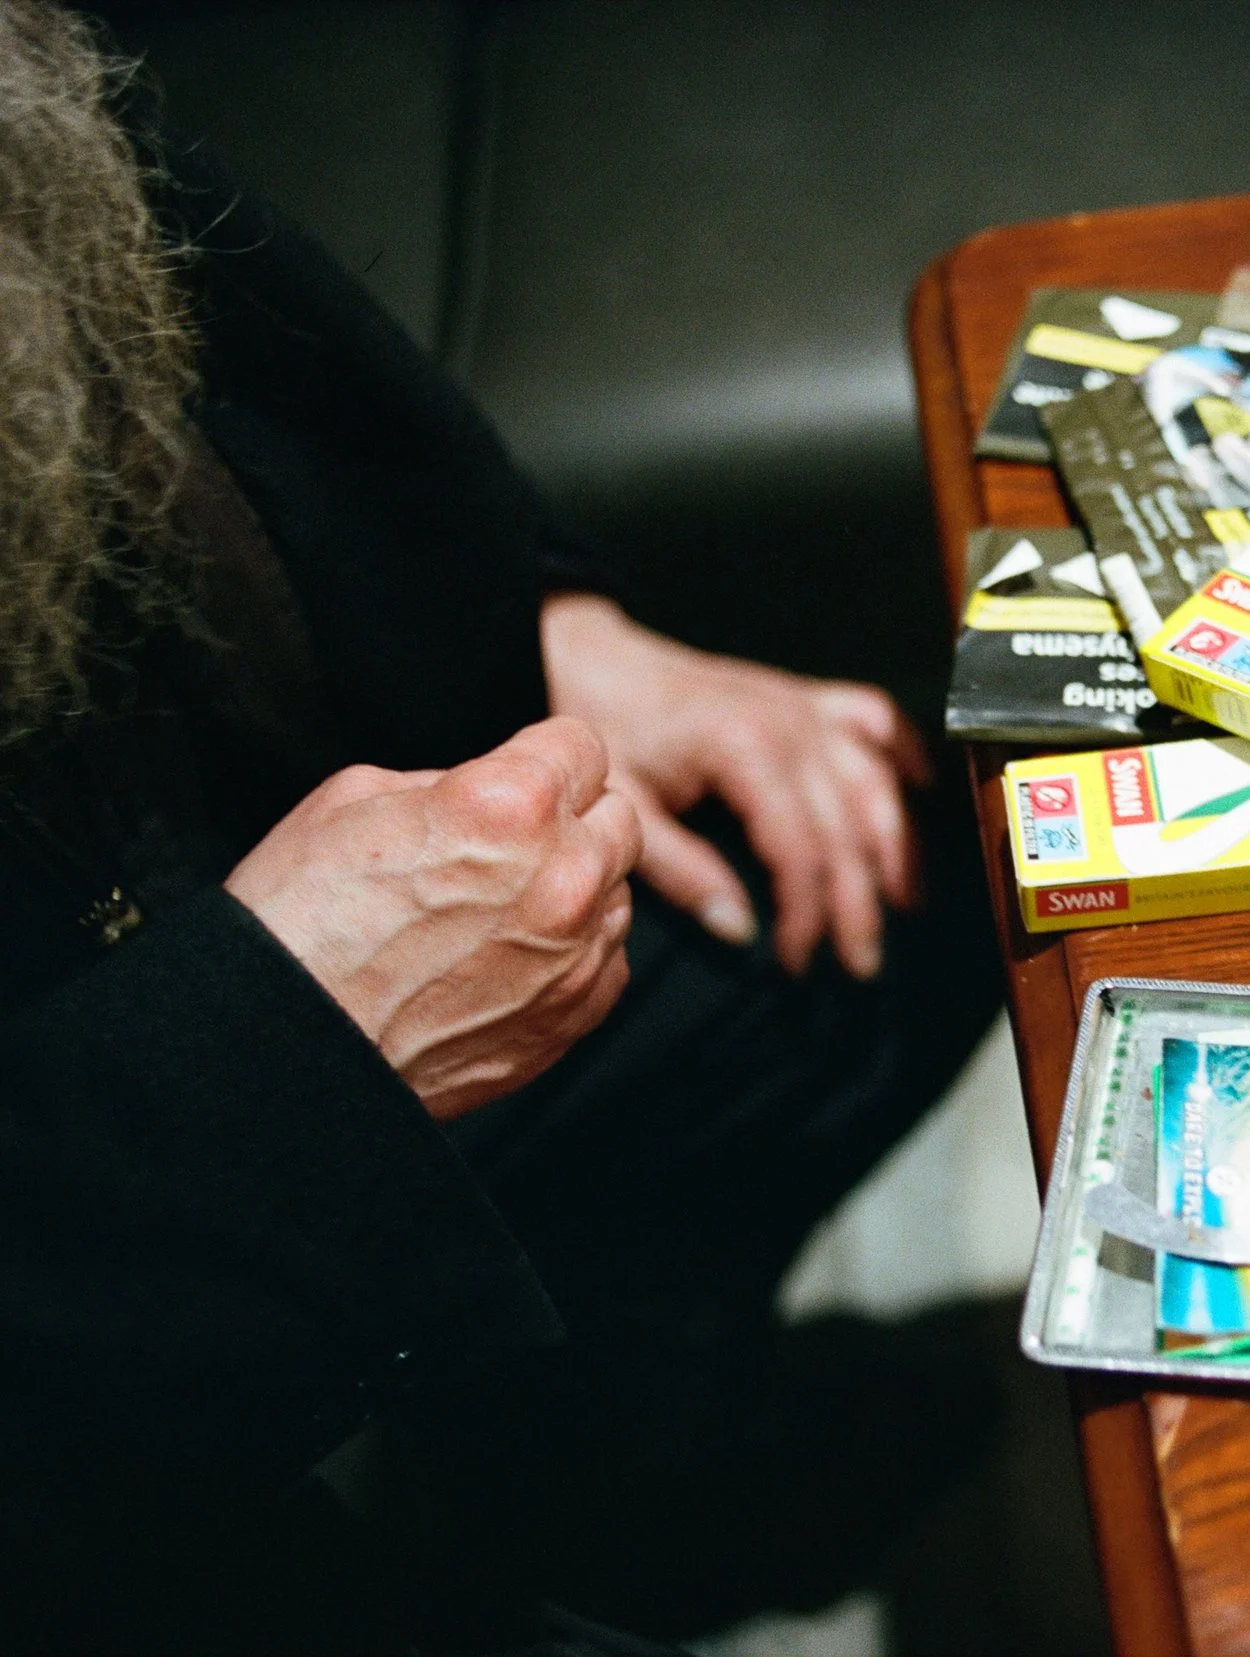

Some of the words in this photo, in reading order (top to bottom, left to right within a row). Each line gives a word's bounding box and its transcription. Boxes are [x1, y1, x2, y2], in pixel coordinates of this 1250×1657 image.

[1062, 682, 1157, 715] oking
[1108, 757, 1145, 817] SWAN
[1048, 889, 1117, 912] SWAN
